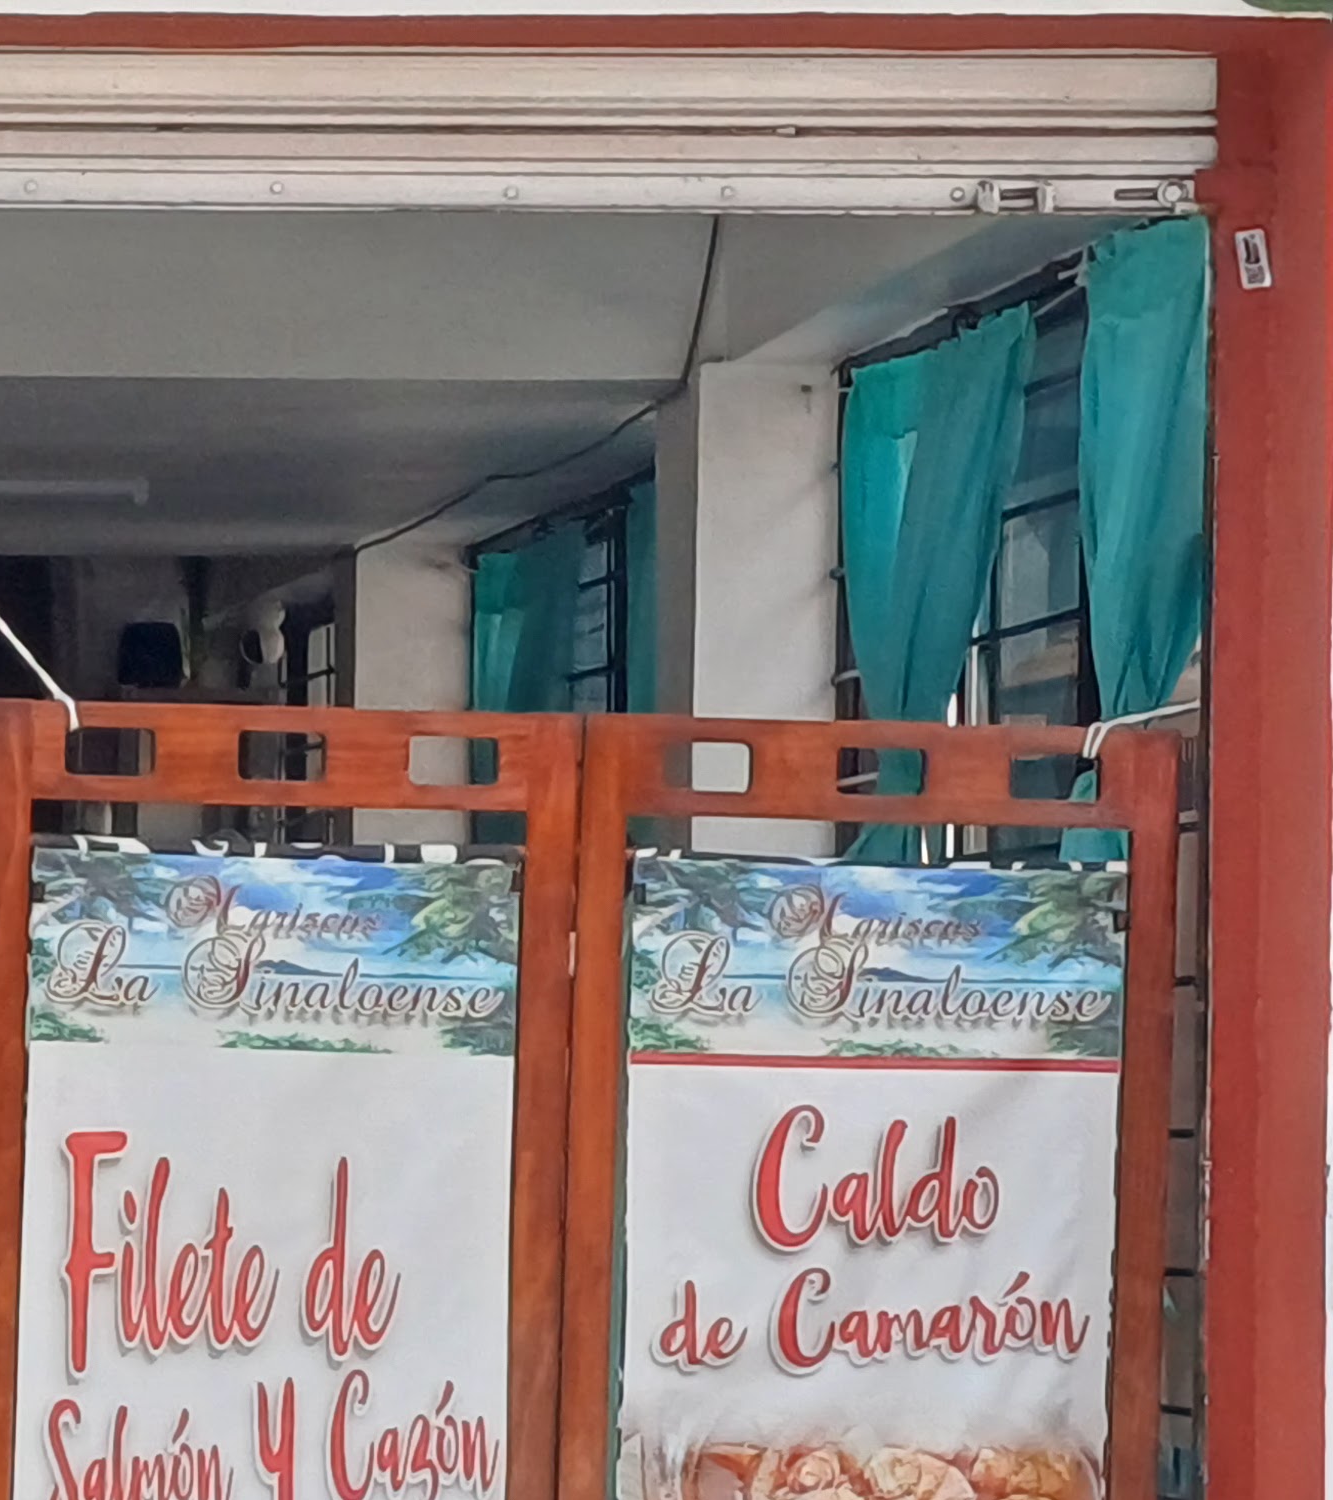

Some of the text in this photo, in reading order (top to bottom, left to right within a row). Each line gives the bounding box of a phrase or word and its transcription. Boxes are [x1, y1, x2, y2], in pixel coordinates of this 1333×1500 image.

[45, 920, 505, 1020] La Sinaloense
[650, 931, 1113, 1024] La Sinaloense
[753, 1103, 1001, 1250] Caldo
[63, 1129, 400, 1374] Filete de
[657, 1266, 1091, 1369] de Camarón
